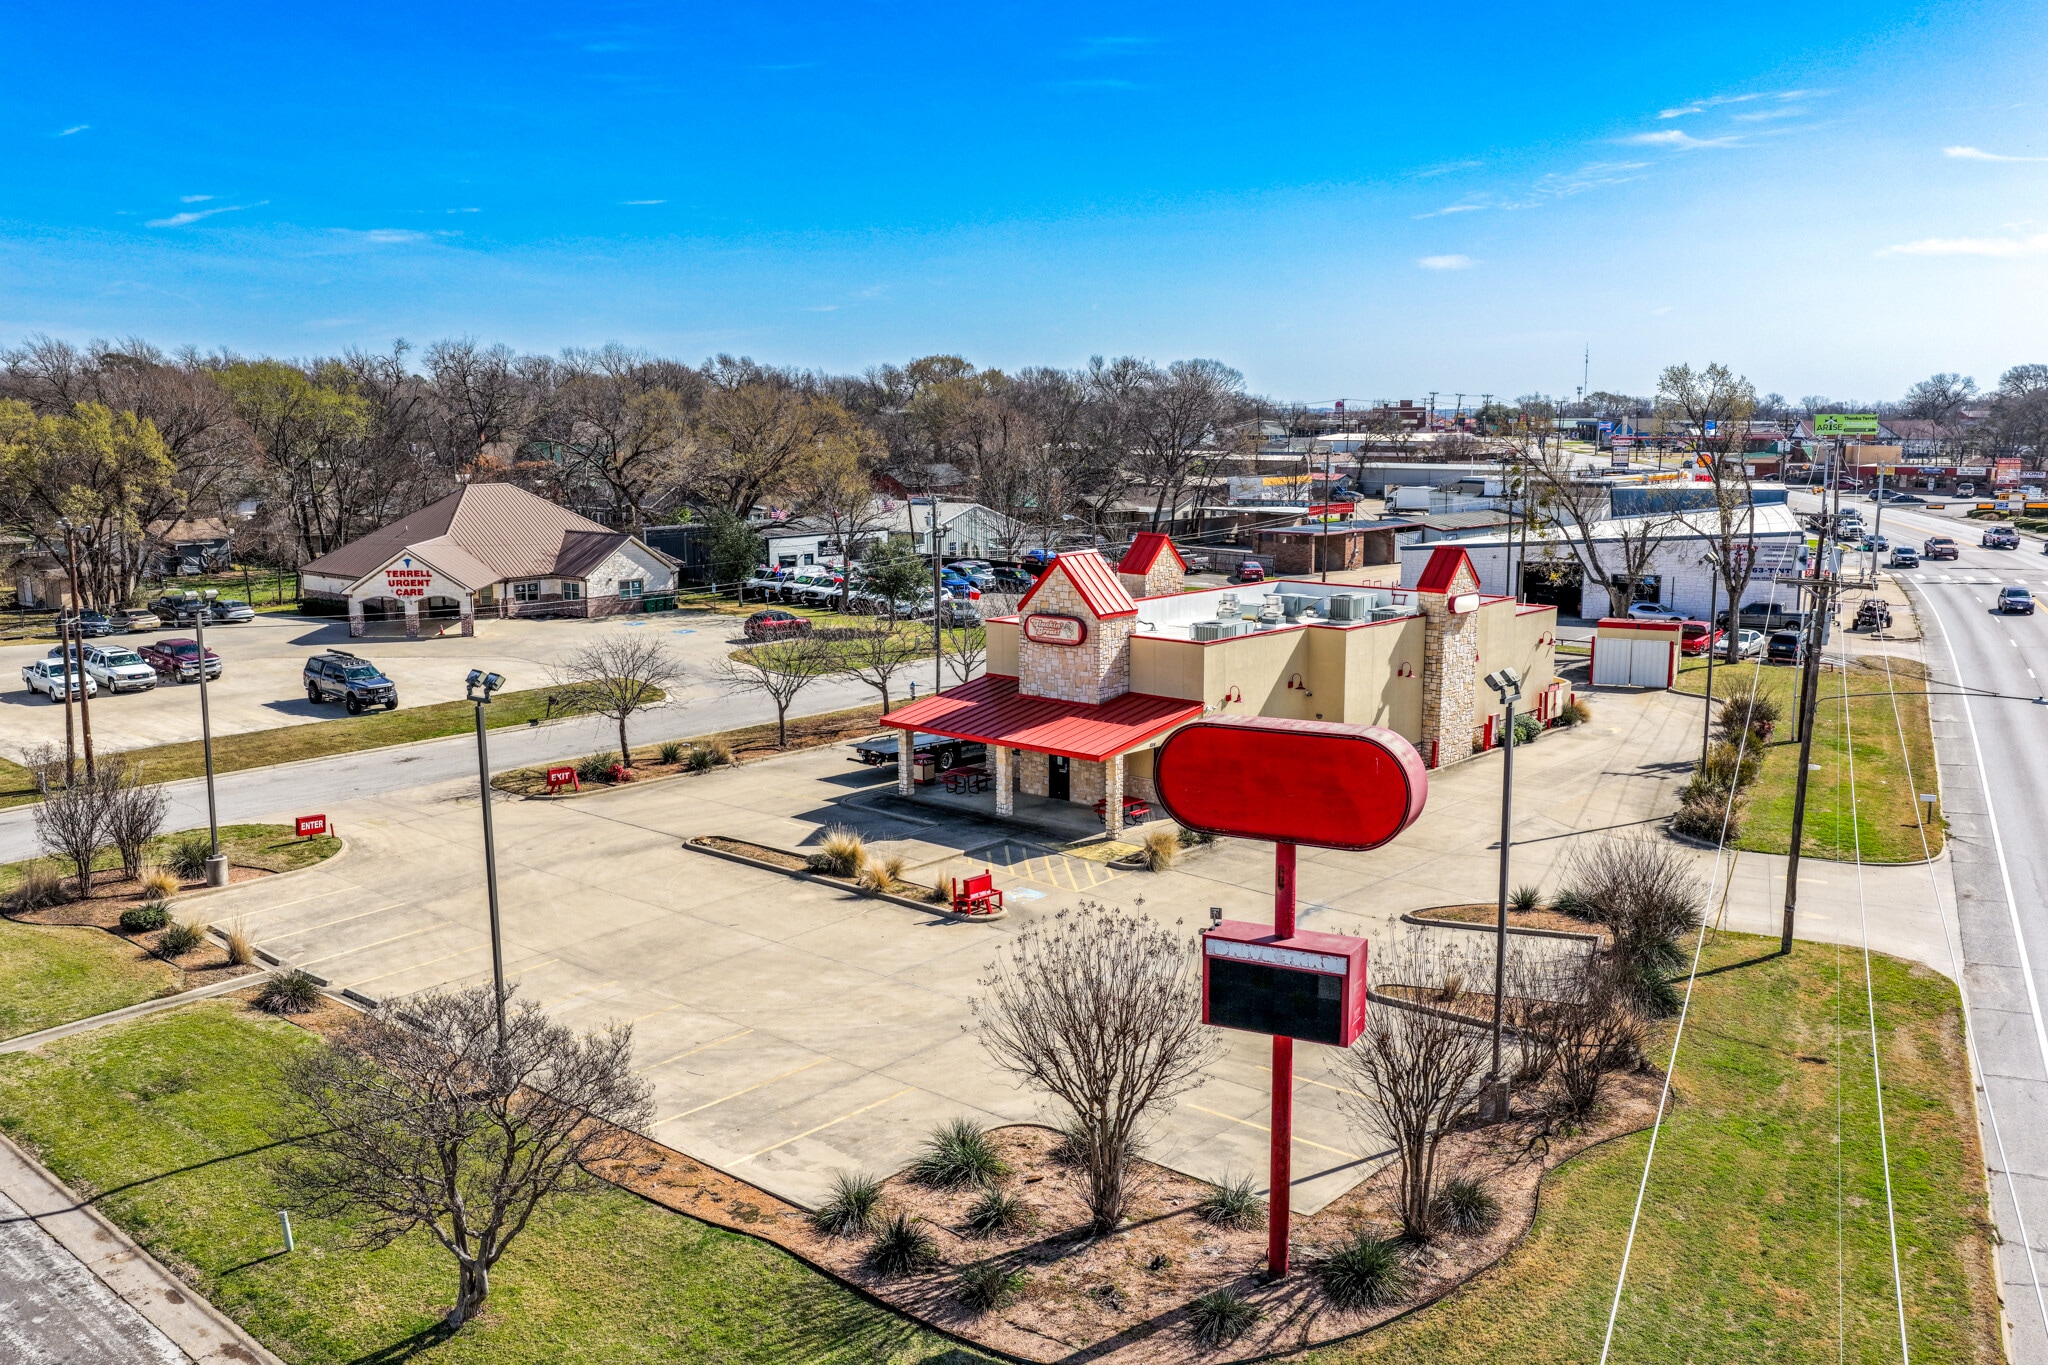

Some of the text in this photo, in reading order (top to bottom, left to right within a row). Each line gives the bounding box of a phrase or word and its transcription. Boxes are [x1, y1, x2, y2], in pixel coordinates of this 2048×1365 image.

[1816, 423, 1843, 431] ARISE
[385, 569, 432, 577] TERRELL
[388, 579, 430, 587] URGENT
[395, 588, 424, 596] CARE
[551, 771, 570, 781] EXIT
[301, 819, 324, 830] ENTER
